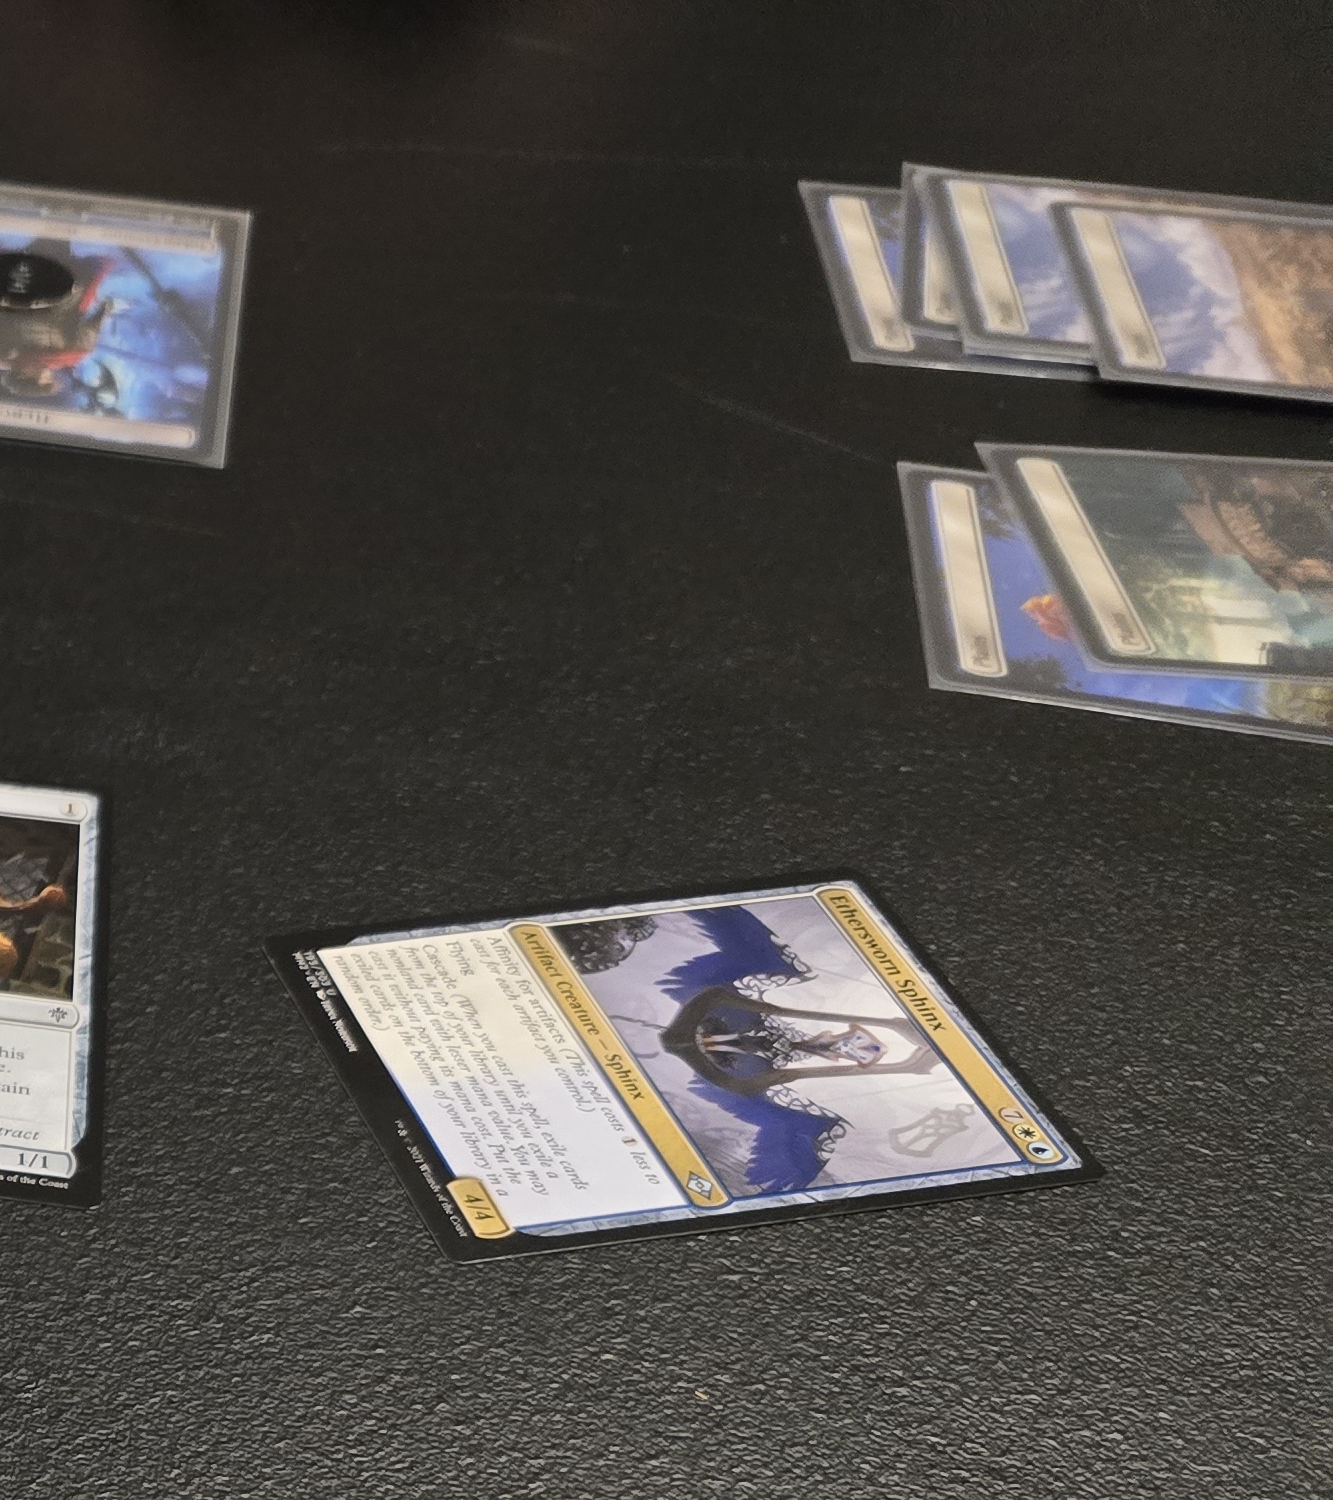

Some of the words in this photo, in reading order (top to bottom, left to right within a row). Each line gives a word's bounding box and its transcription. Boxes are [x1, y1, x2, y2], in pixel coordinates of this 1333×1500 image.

[416, 943, 465, 990] Cascade
[439, 941, 481, 975] Flying
[481, 936, 527, 976] Affinity
[825, 895, 908, 975] Ethersworn
[889, 978, 952, 1031] Sphinx
[512, 979, 539, 995] for
[516, 931, 566, 978] Artifact
[550, 981, 606, 1035] Creature
[596, 1053, 650, 1100] Sphinx
[523, 998, 571, 1043] artifacts
[17, 1153, 48, 1168] 1/1
[458, 1193, 495, 1221] 4/4
